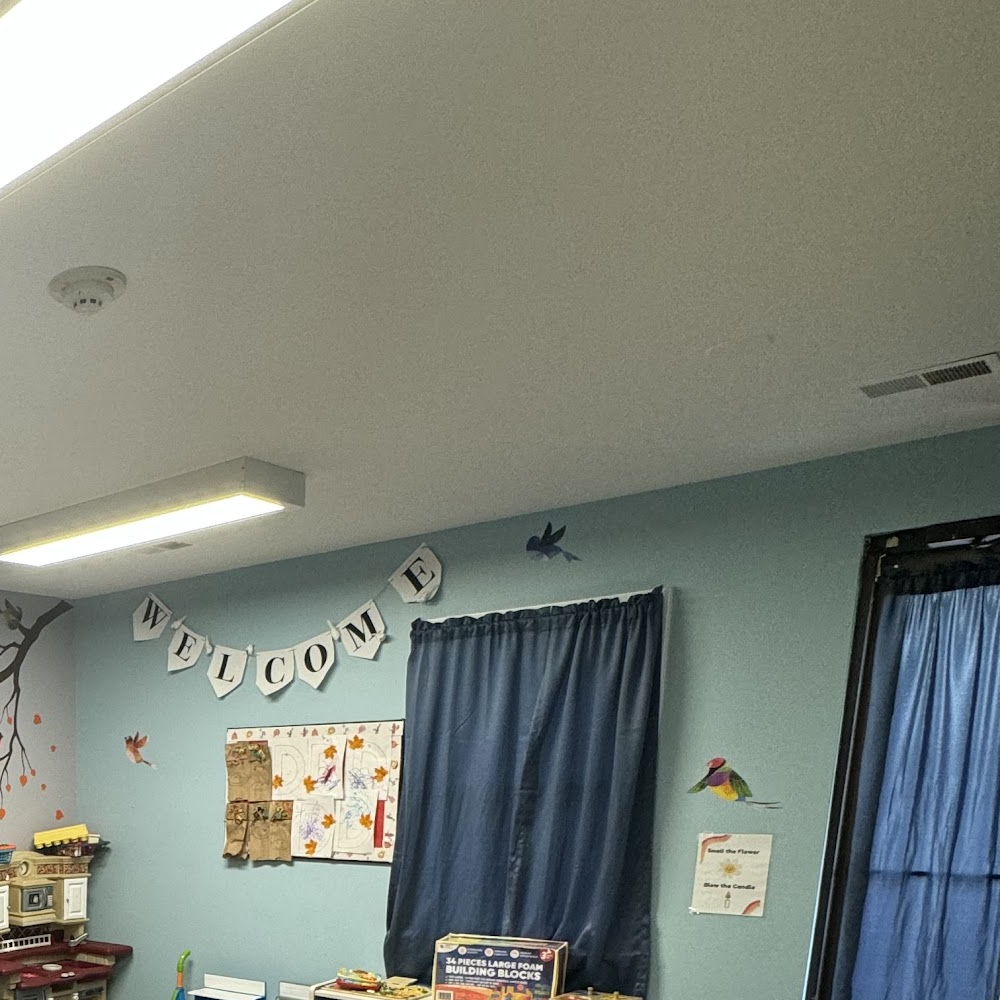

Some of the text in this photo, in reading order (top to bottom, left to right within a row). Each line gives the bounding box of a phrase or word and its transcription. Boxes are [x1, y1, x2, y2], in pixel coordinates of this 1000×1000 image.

[142, 557, 436, 685] WELCOME
[445, 957, 544, 972] 34 PIECES LARGE FOAM
[445, 965, 496, 978] BUILDING
[497, 968, 541, 981] BLOCKS
